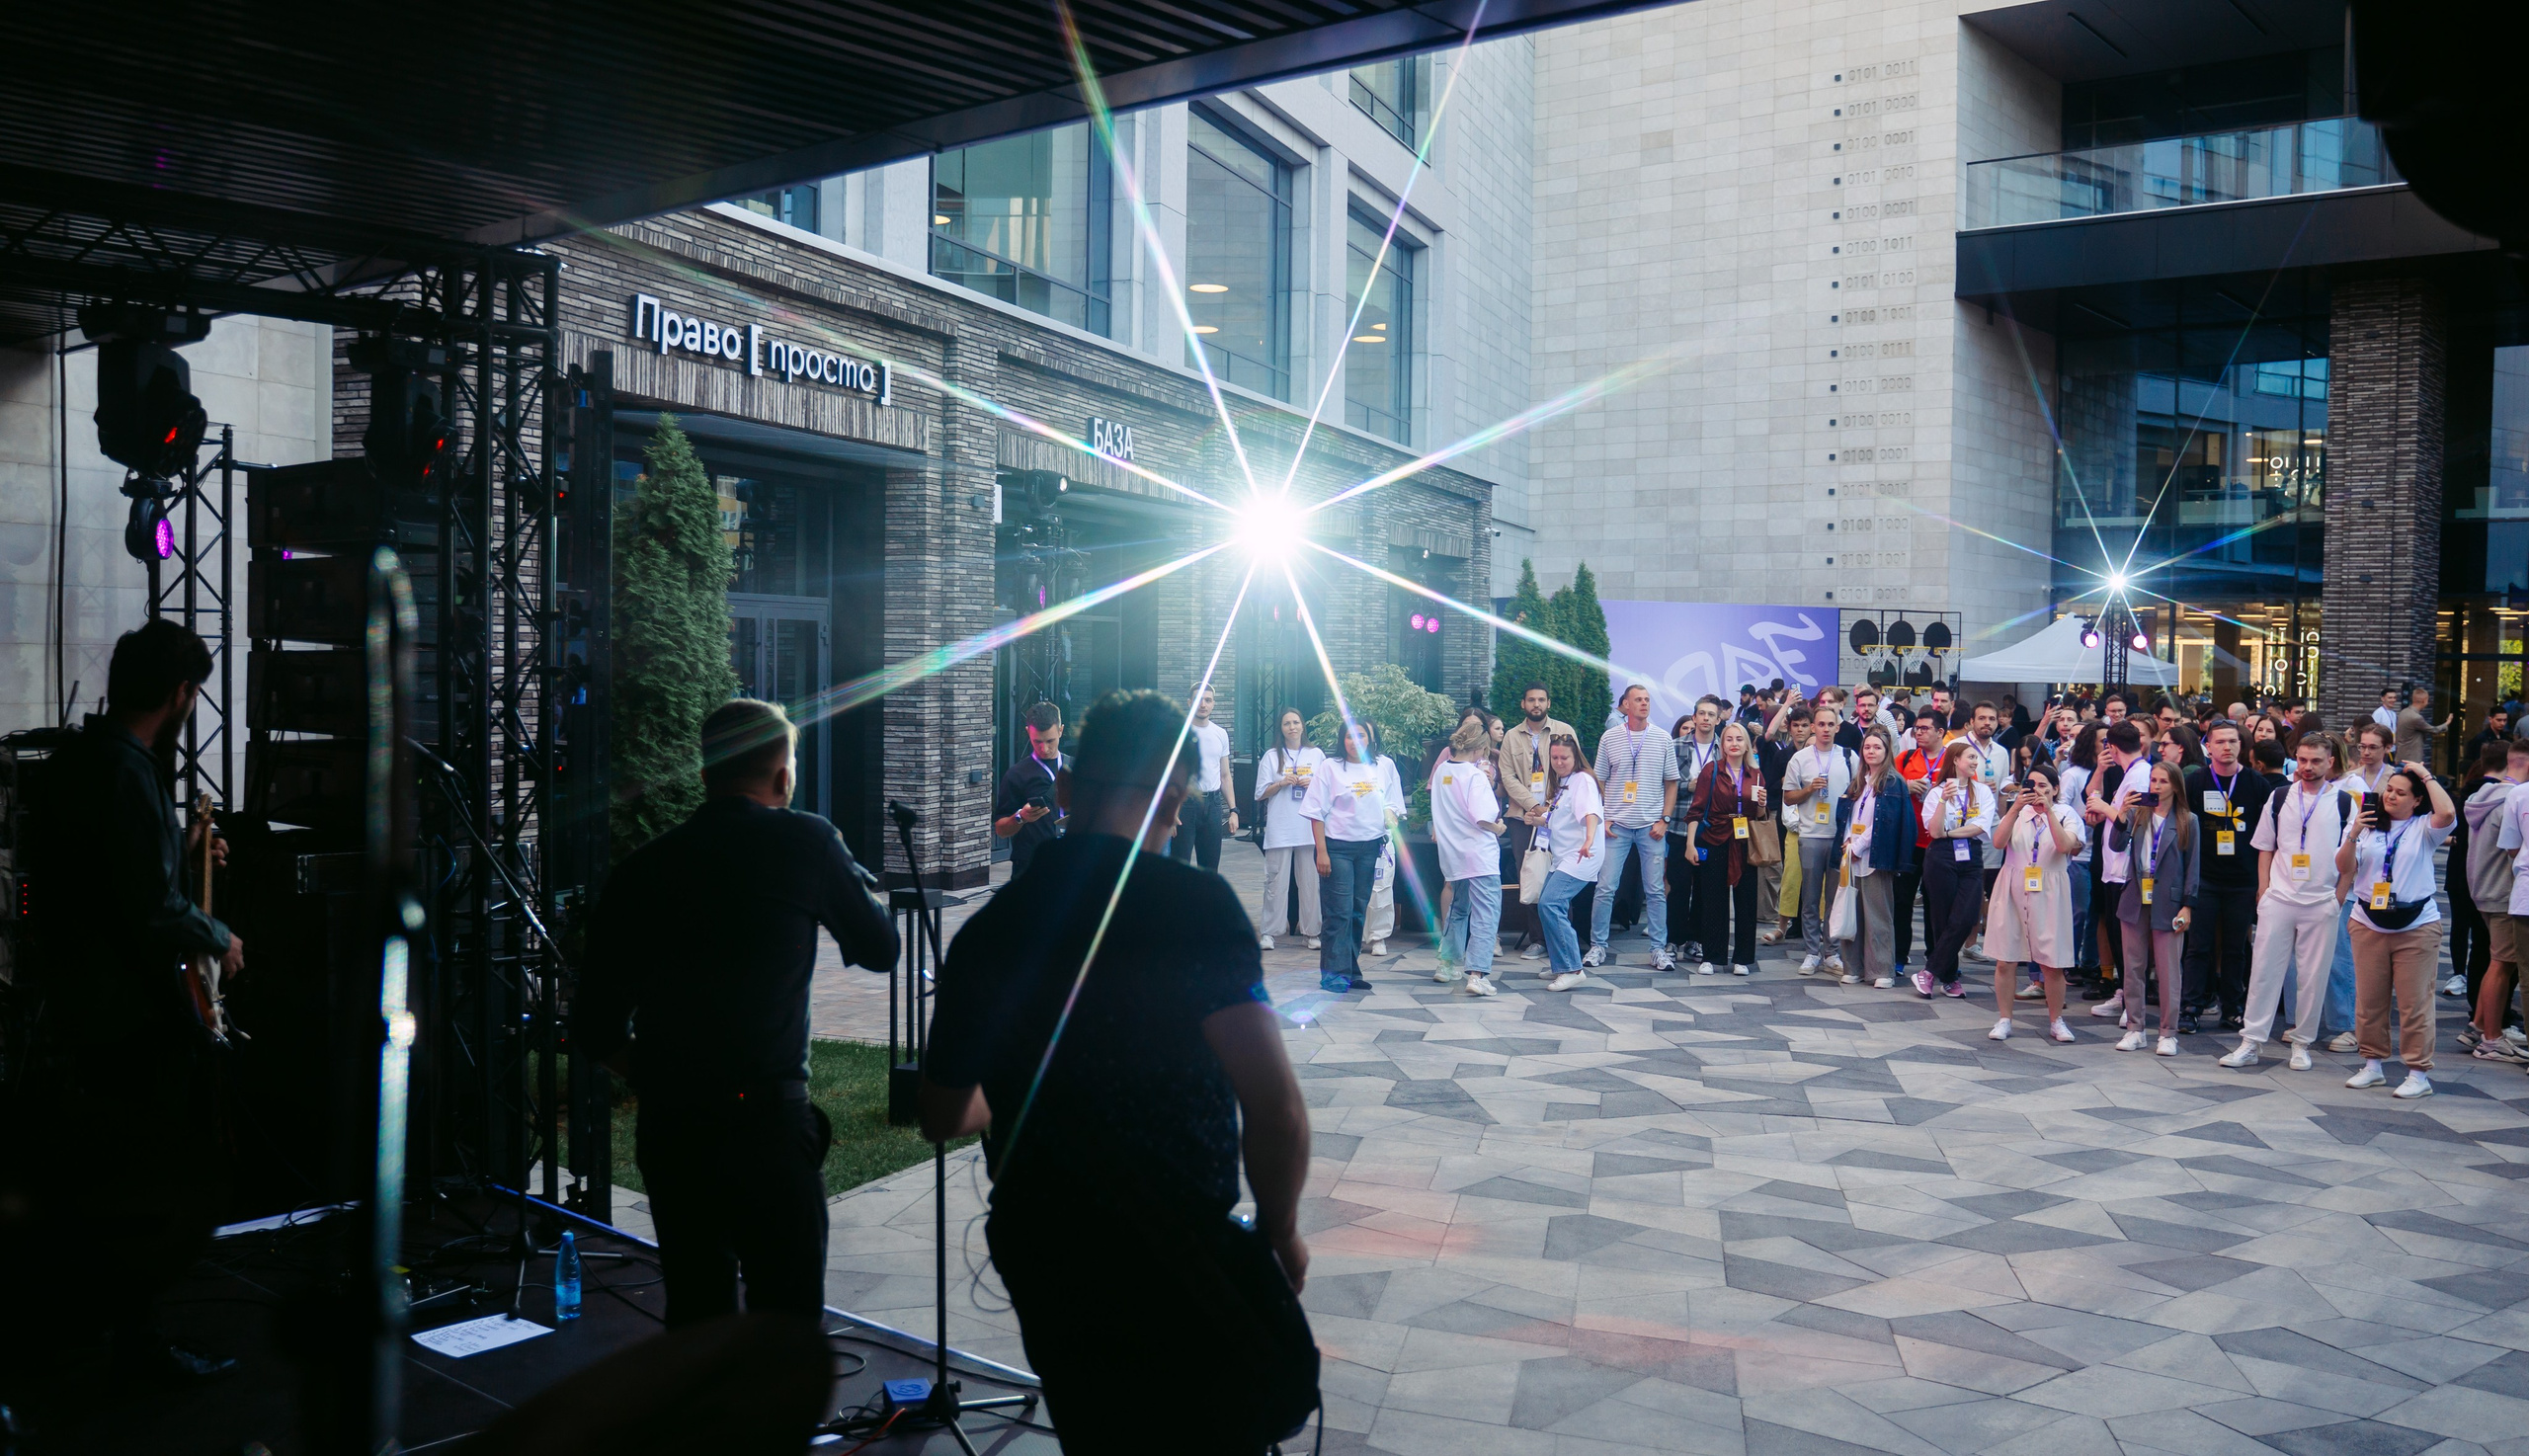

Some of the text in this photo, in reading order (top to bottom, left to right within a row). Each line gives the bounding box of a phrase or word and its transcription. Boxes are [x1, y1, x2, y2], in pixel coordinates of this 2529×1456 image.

[1848, 60, 1915, 82] 0101 0011
[1848, 95, 1916, 116] 0101 0000
[1846, 130, 1914, 150] 0100 0001
[1847, 165, 1914, 185] 0101 0010
[1846, 201, 1914, 219] 0100 0001
[1846, 235, 1913, 254] 0100 1011
[1845, 271, 1914, 288] 0101 0100
[1845, 306, 1912, 323] 0100 1001
[633, 292, 742, 362] Право
[1843, 342, 1911, 358] 0100 0111
[1843, 379, 1873, 392] 0101
[1843, 412, 1911, 428] 0100 0010
[1088, 416, 1134, 460] БАЗА
[1842, 447, 1909, 463] 0100 0001
[1842, 484, 1871, 496] 0101
[1841, 518, 1908, 530] 0100 1000
[1841, 553, 1871, 566] 0100
[1840, 587, 1908, 600] 0101 0010
